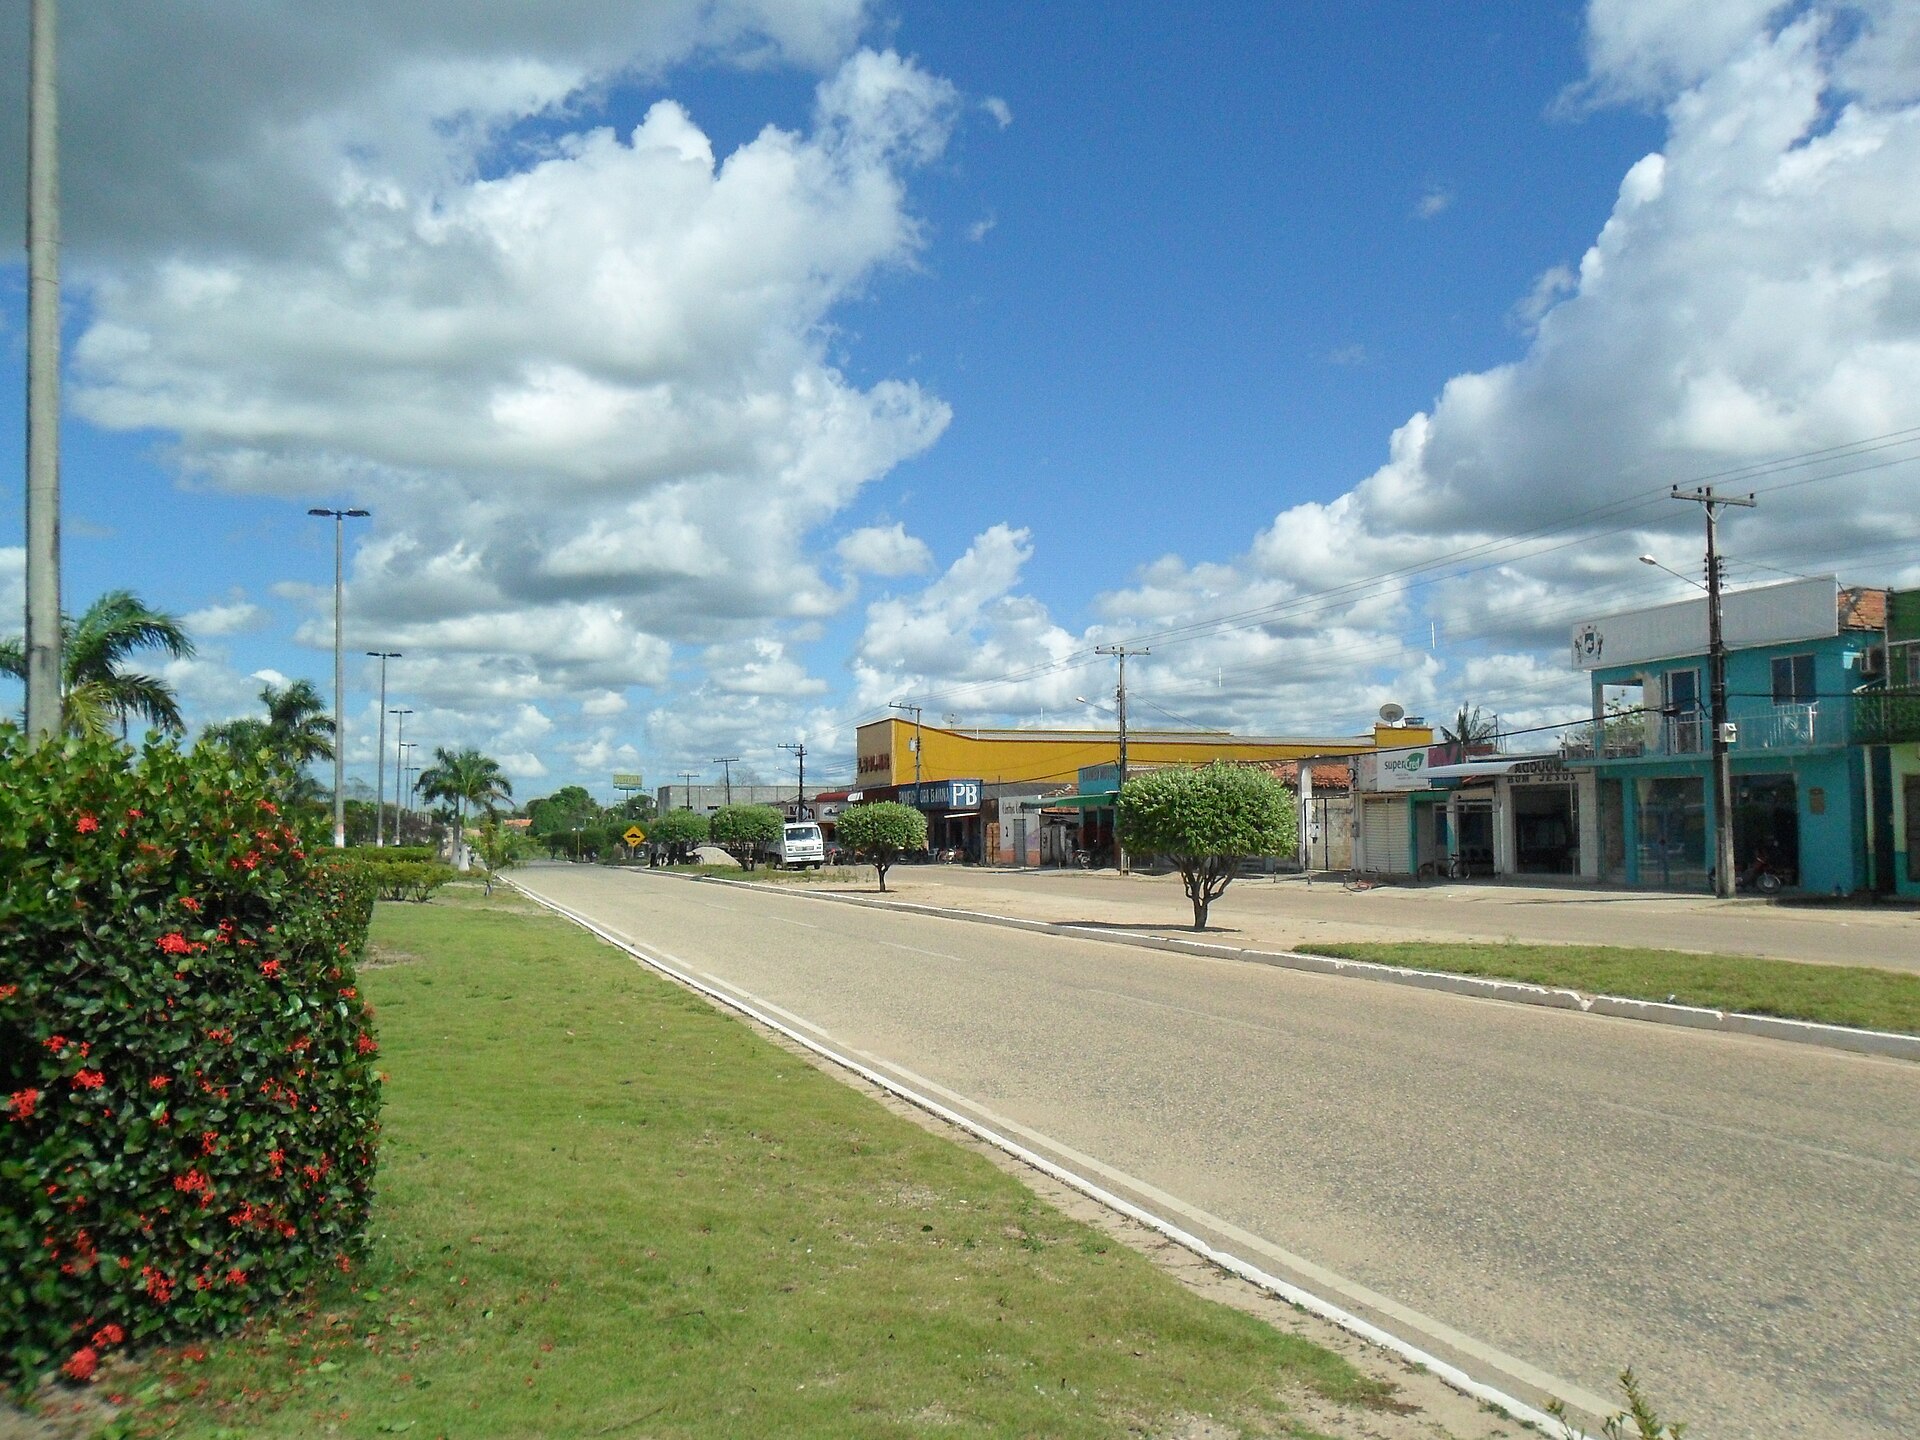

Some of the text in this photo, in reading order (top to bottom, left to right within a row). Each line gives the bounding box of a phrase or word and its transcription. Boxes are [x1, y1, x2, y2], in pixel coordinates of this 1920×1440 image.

[1507, 772, 1577, 785] BOM JESUS
[953, 783, 977, 806] PB
